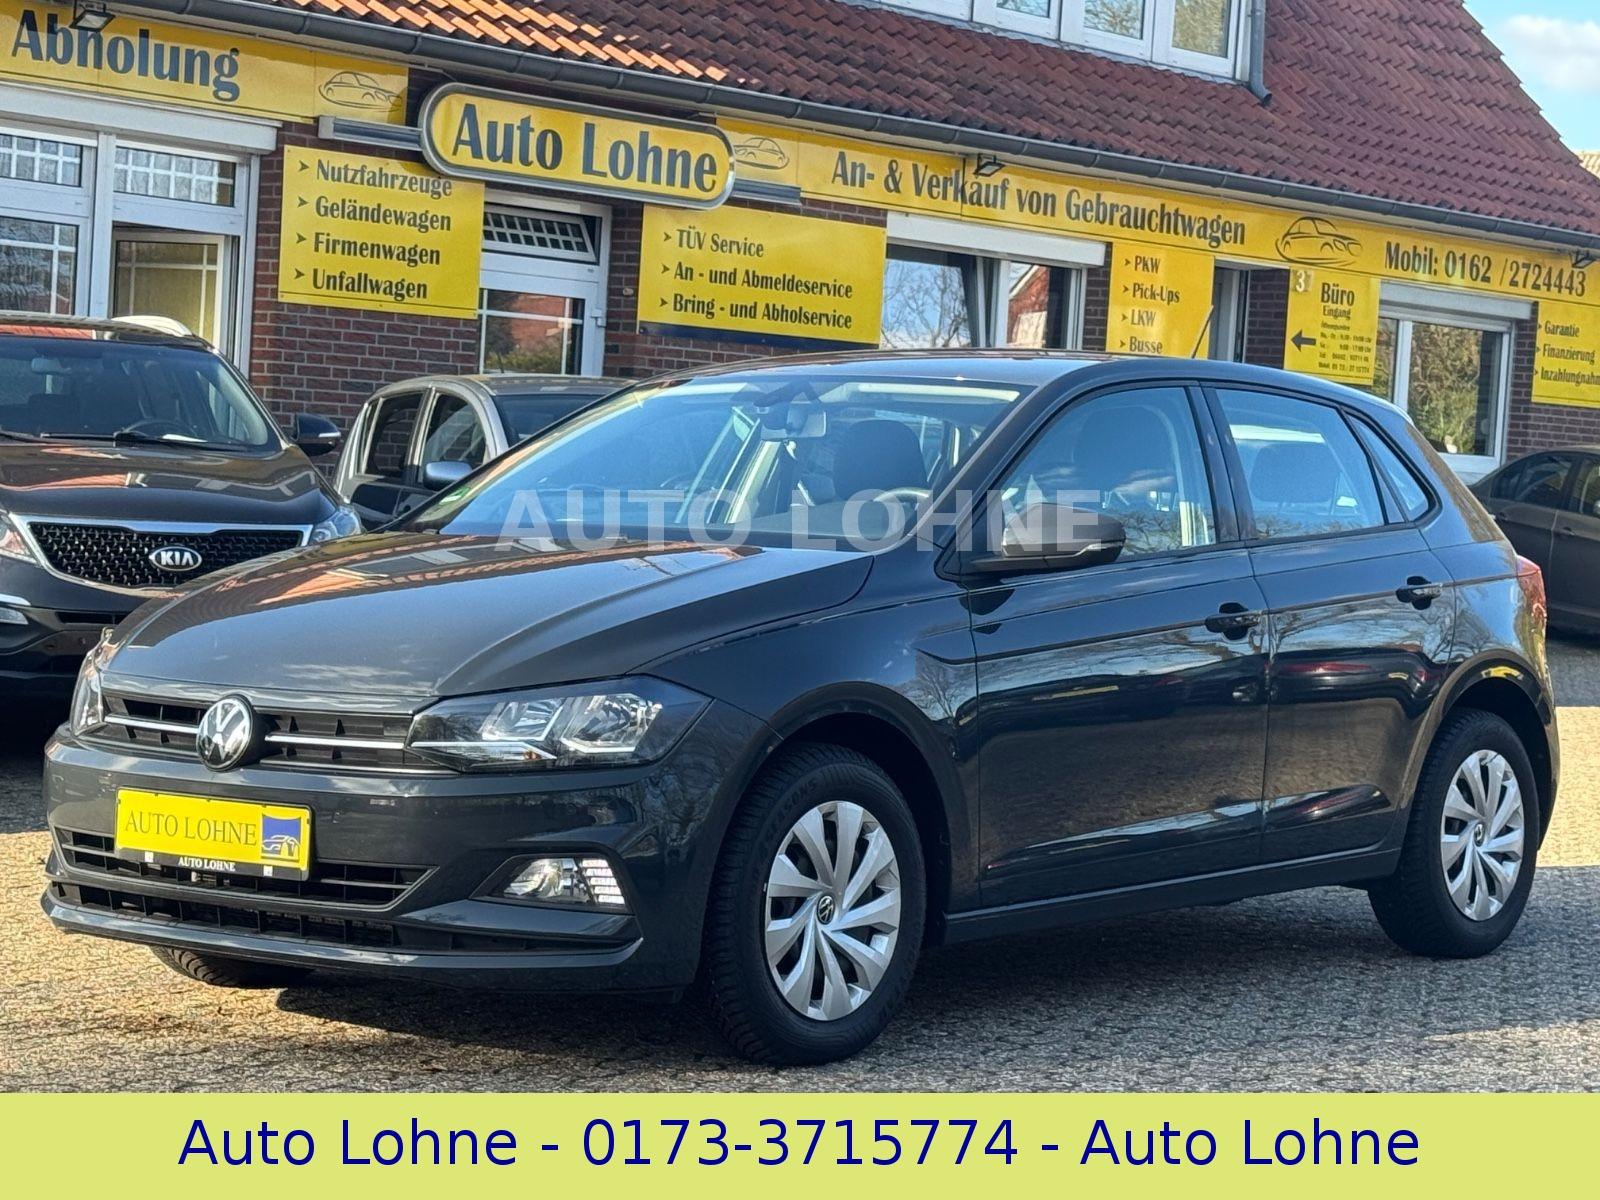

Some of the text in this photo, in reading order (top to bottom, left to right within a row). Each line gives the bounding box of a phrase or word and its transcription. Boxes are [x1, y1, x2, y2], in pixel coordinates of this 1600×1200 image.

[12, 10, 240, 101] Abholung
[452, 103, 716, 192] Auto Lohne
[316, 159, 452, 197] Nutzfahrzeuge
[315, 195, 451, 231] Geländewagen
[832, 151, 1245, 248] An- & Verkauf von Gebrauchtwagen
[314, 232, 441, 267] Firmenwagen
[676, 226, 764, 257] TÜV Service
[674, 261, 694, 282] An
[709, 268, 737, 287] und
[742, 271, 853, 299] Abmeldeservice
[1134, 255, 1160, 274] PKW
[1385, 241, 1586, 297] Mobil: 0162 /2724443
[312, 268, 428, 300] Unfallwagen
[1132, 283, 1180, 305] Pick-Ups
[1321, 282, 1355, 306] Büro
[673, 294, 715, 320] Bring
[730, 301, 756, 319] und
[762, 304, 852, 329] Abholservice
[1130, 309, 1156, 327] LKW
[1322, 306, 1351, 320] Eingang
[1544, 320, 1580, 337] Garantie
[1129, 336, 1163, 354] Busse
[1542, 343, 1595, 365] Finanzierung
[160, 551, 194, 566] KIA
[125, 809, 257, 846] AUTO LOHNE
[178, 856, 235, 872] AUTO LOHNE
